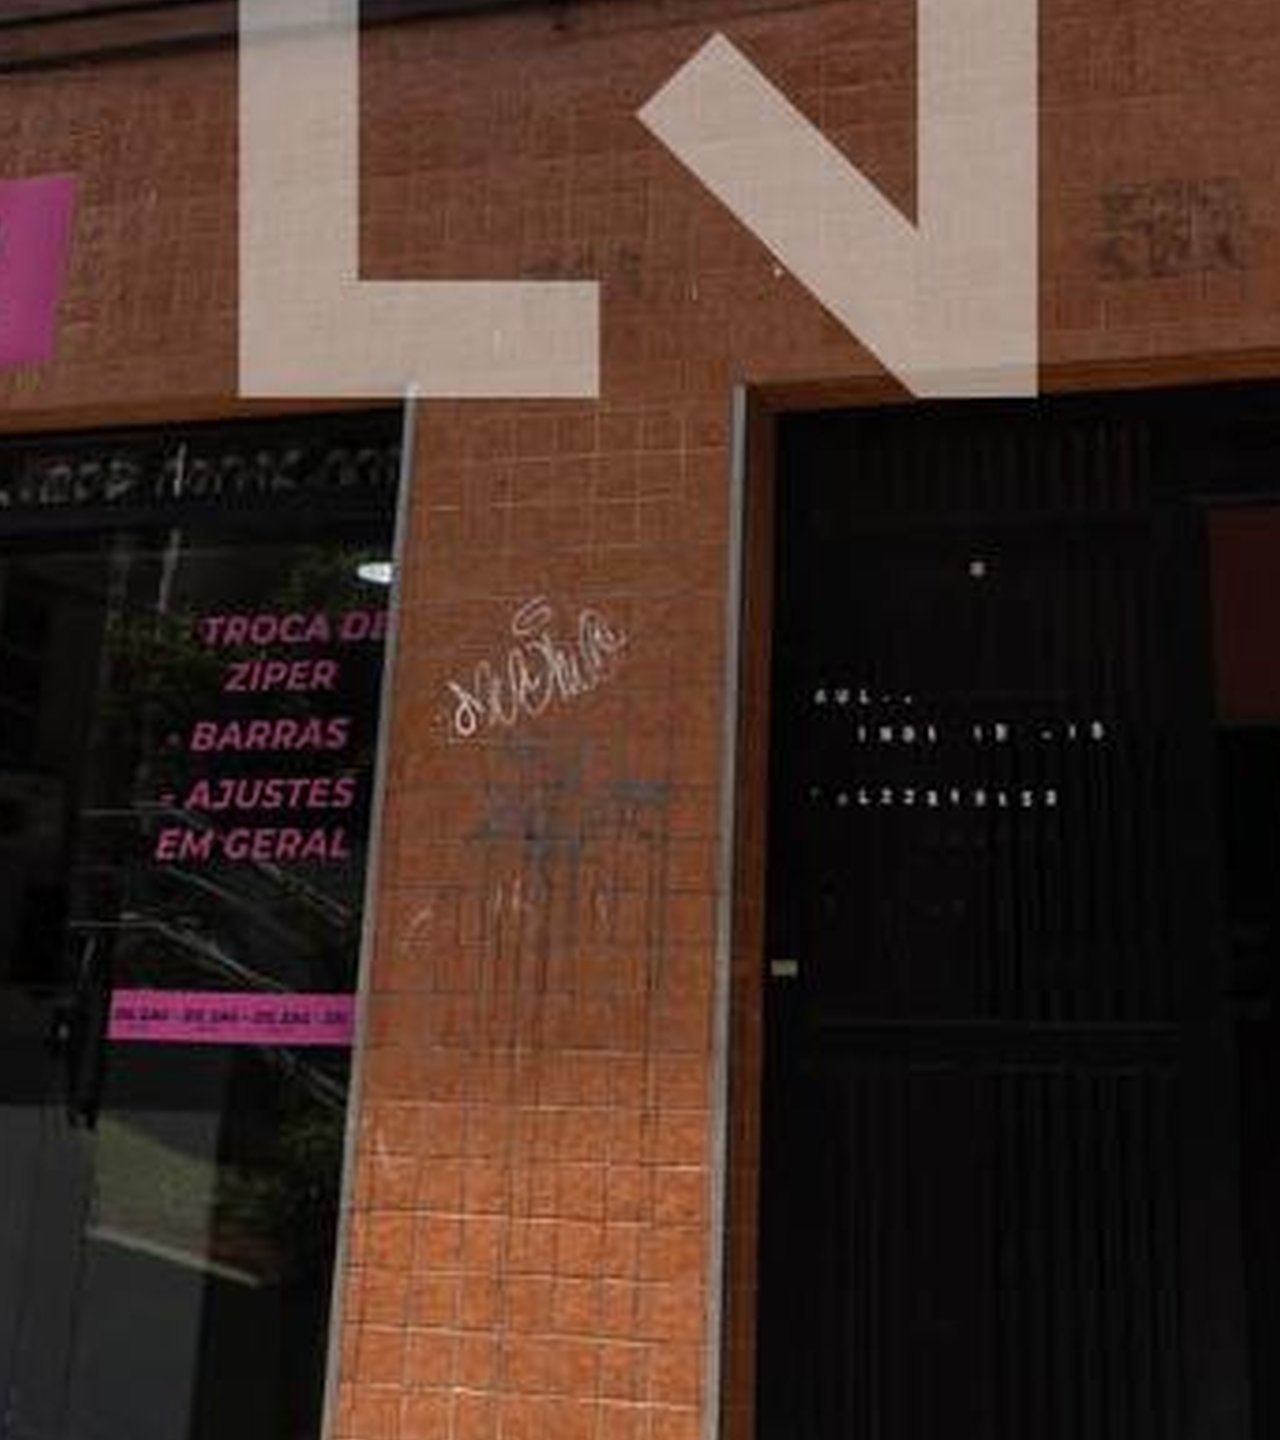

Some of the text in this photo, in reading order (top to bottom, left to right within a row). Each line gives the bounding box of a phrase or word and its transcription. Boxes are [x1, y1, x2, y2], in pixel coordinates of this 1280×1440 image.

[199, 612, 331, 646] TROCA
[223, 660, 341, 692] ZIPER
[190, 717, 351, 752] BARRAS
[184, 777, 357, 810] AJUSTES
[155, 826, 351, 862] EM GERAL
